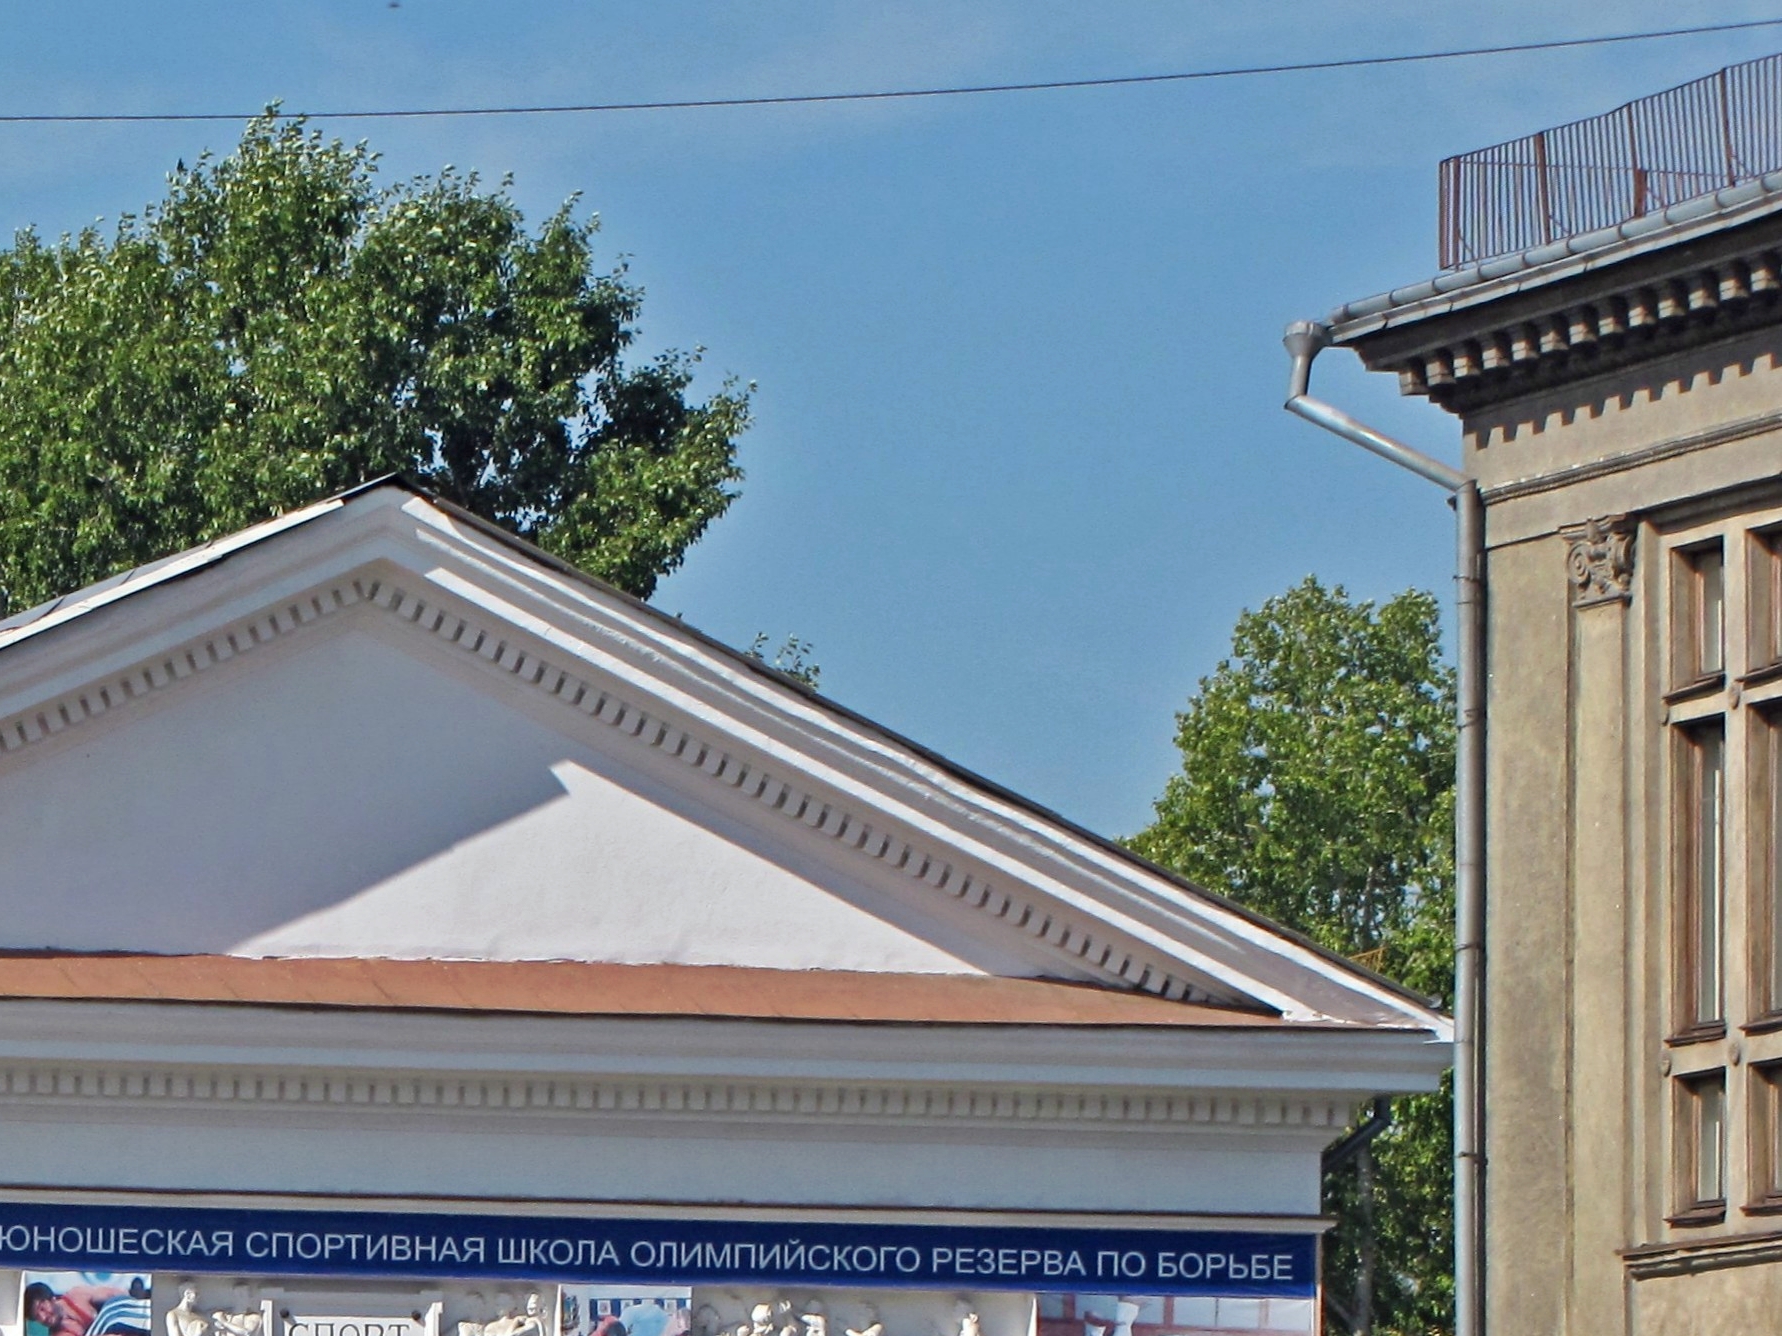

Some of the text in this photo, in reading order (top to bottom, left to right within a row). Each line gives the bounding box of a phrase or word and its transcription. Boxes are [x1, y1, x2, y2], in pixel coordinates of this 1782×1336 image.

[246, 1231, 485, 1264] СПОРТИВНАЯ
[498, 1238, 619, 1267] ШКОЛА
[630, 1238, 921, 1274] ОЛИМПИЙСКОГО
[933, 1248, 1086, 1277] РЕЗЕРВА
[1097, 1250, 1146, 1279] ПО
[1158, 1253, 1292, 1281] БОРЬБЕ
